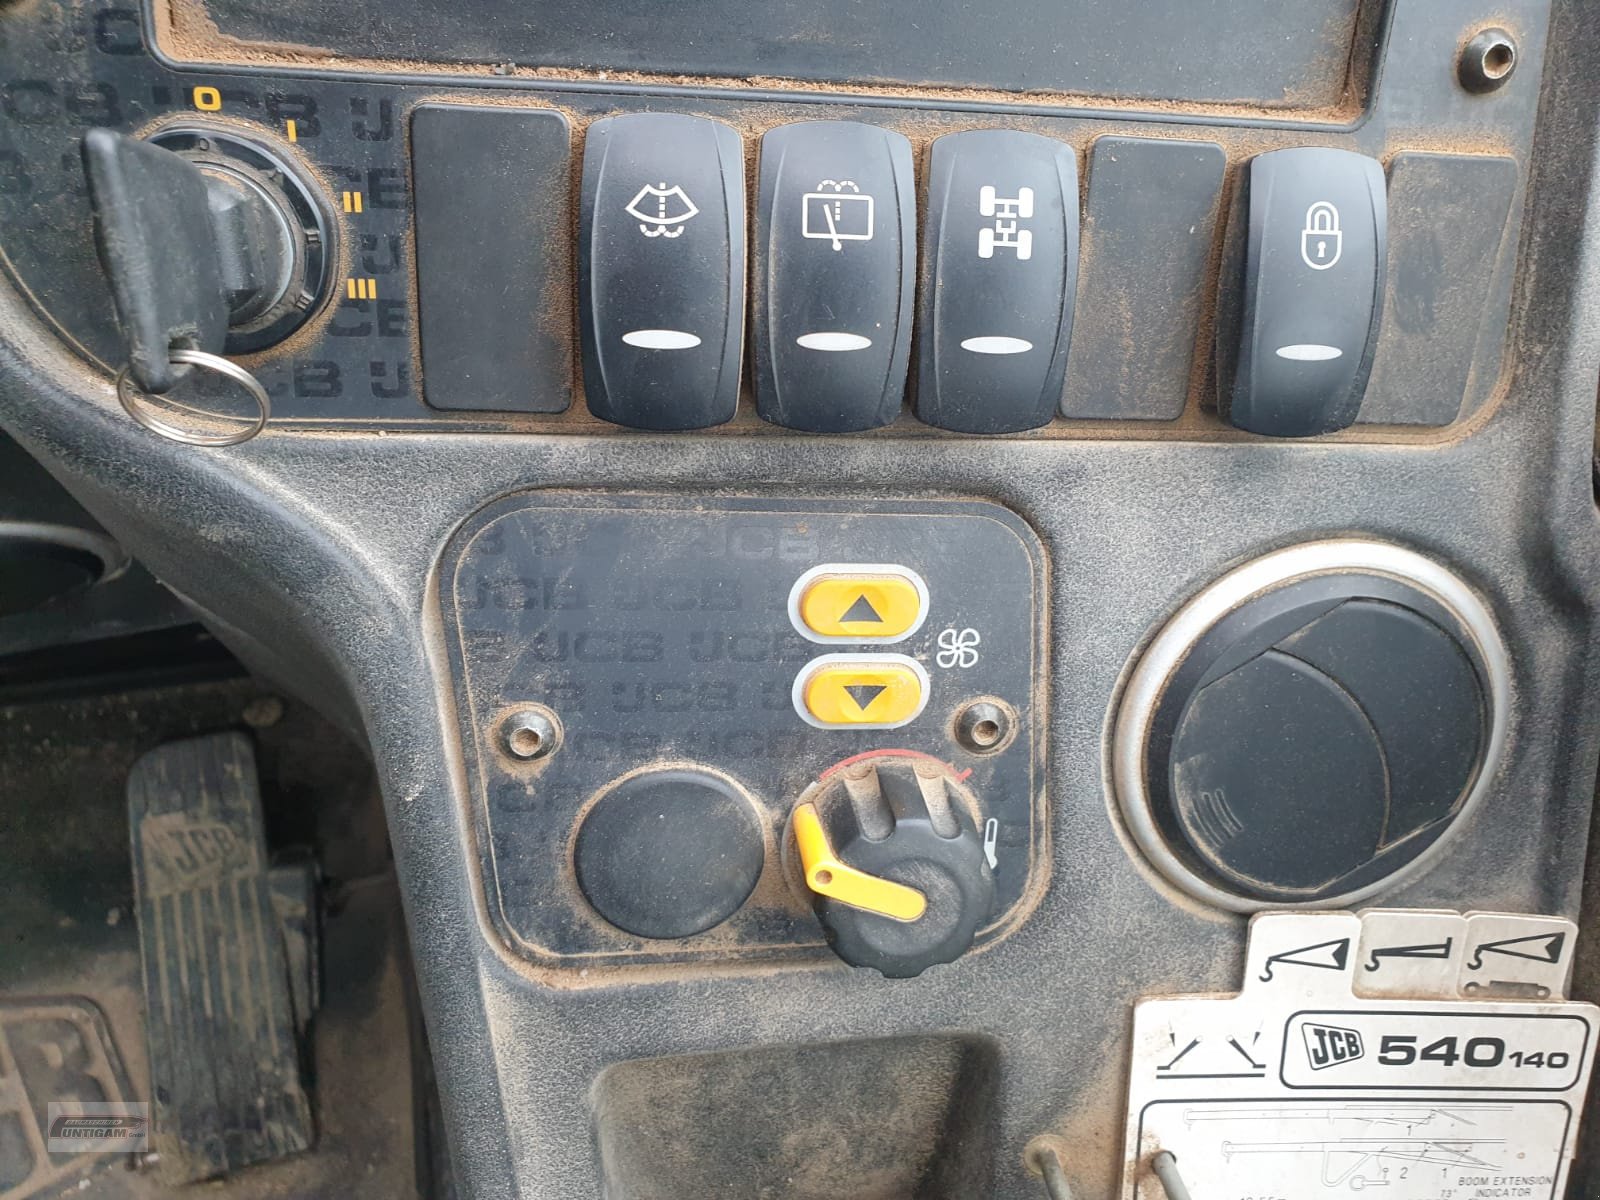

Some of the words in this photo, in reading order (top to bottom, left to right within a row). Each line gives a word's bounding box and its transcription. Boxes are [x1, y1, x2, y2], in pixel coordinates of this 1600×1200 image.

[343, 191, 362, 213] II
[347, 278, 376, 299] III
[534, 632, 664, 664] JCB
[173, 823, 236, 870] JCB
[1312, 1028, 1361, 1065] JCB
[1377, 1034, 1506, 1068] 540
[1508, 1051, 1570, 1069] 140
[1399, 1166, 1409, 1180] 2
[1458, 1176, 1489, 1187] BOOM
[1493, 1176, 1552, 1187] EXTENSION
[1476, 1187, 1532, 1198] INDICATOR
